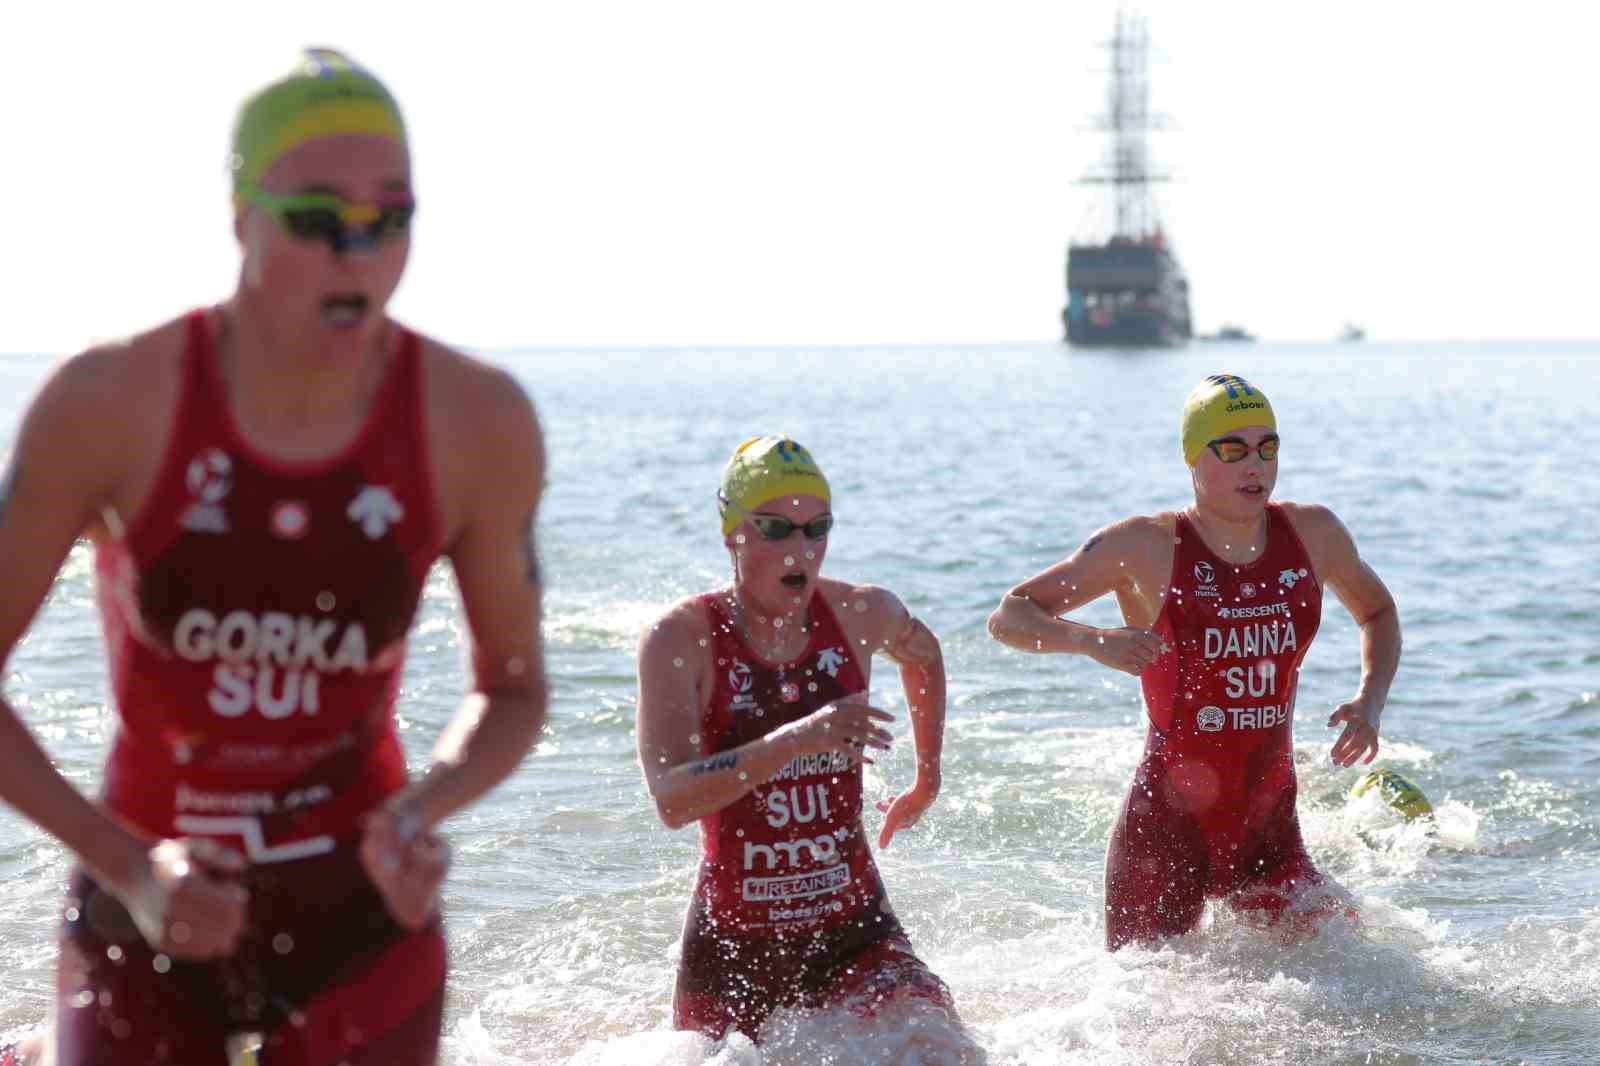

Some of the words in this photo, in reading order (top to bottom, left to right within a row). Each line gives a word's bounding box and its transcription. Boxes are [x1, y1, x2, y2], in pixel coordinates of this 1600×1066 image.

[1231, 602, 1290, 618] DESCENTE
[174, 609, 368, 670] GORKA
[1205, 622, 1296, 659] DANNA
[209, 664, 319, 718] SUI
[1225, 663, 1276, 698] SUI
[767, 784, 831, 828] SUI
